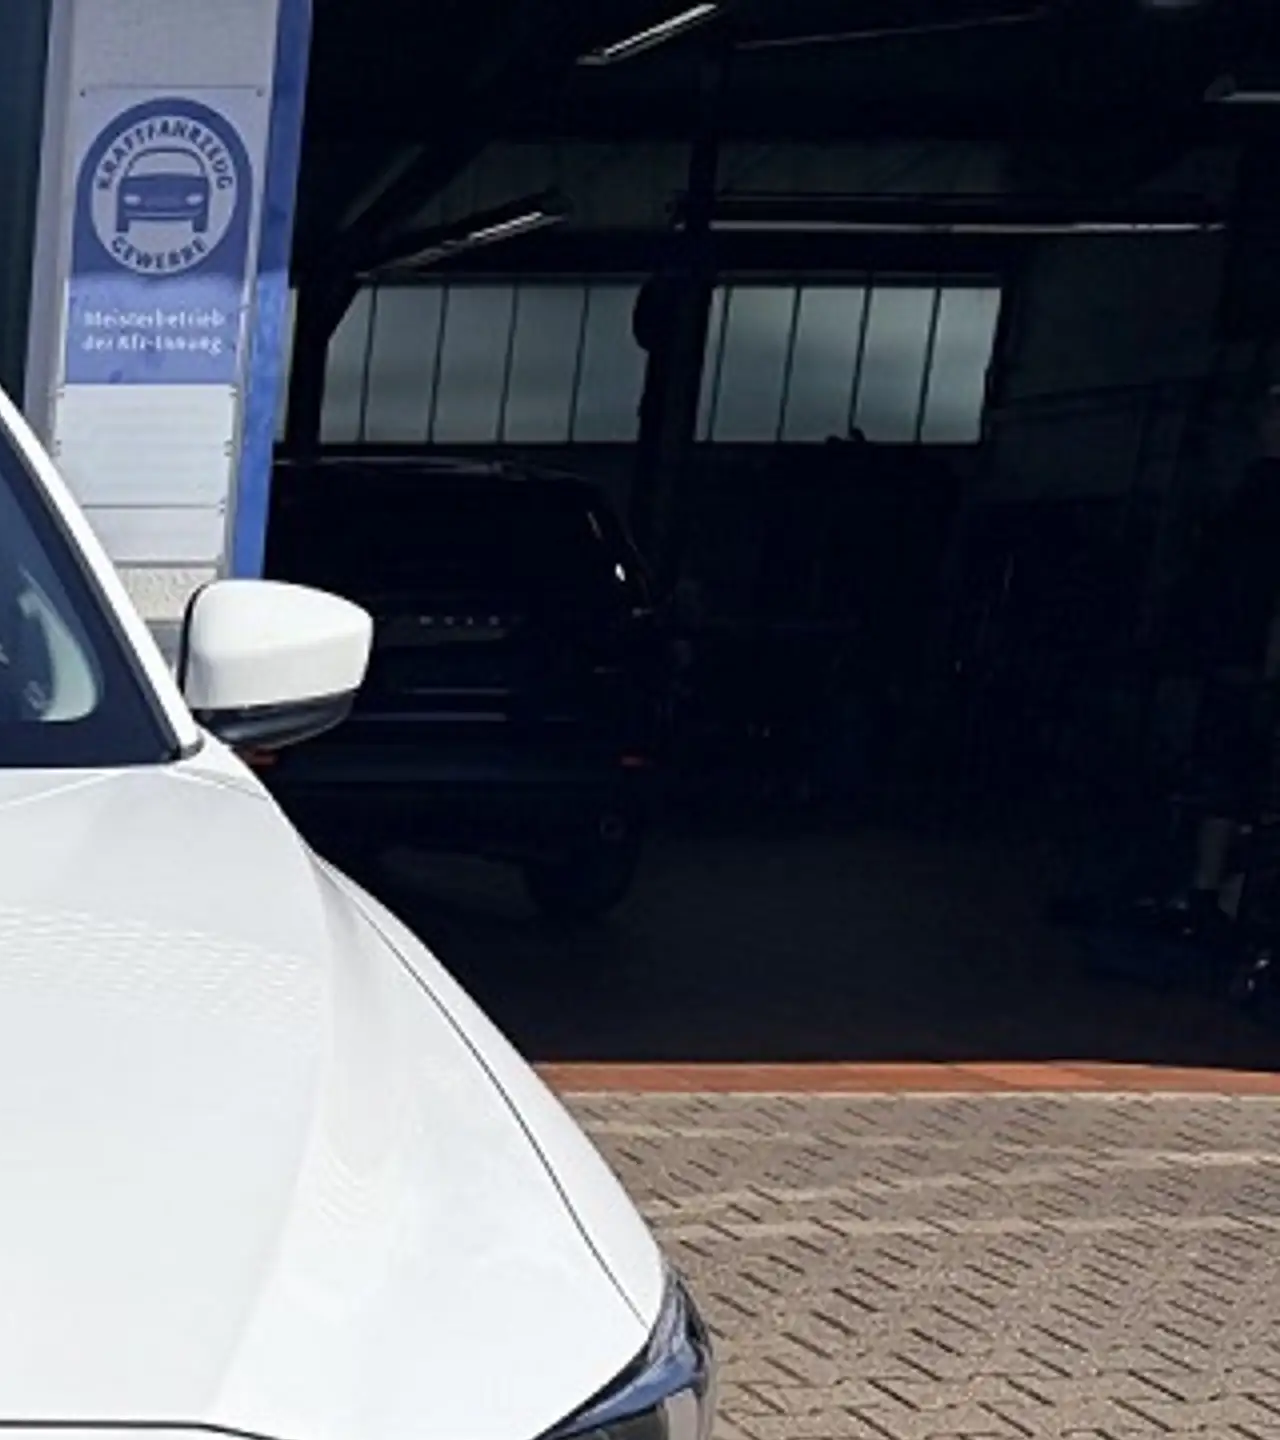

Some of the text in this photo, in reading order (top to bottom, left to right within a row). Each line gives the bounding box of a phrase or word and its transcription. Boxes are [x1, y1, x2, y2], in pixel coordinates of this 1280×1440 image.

[97, 118, 234, 191] KRAFTFAHRZEUG
[110, 234, 208, 271] GEWERBE
[83, 307, 226, 329] Meisterbetrieb
